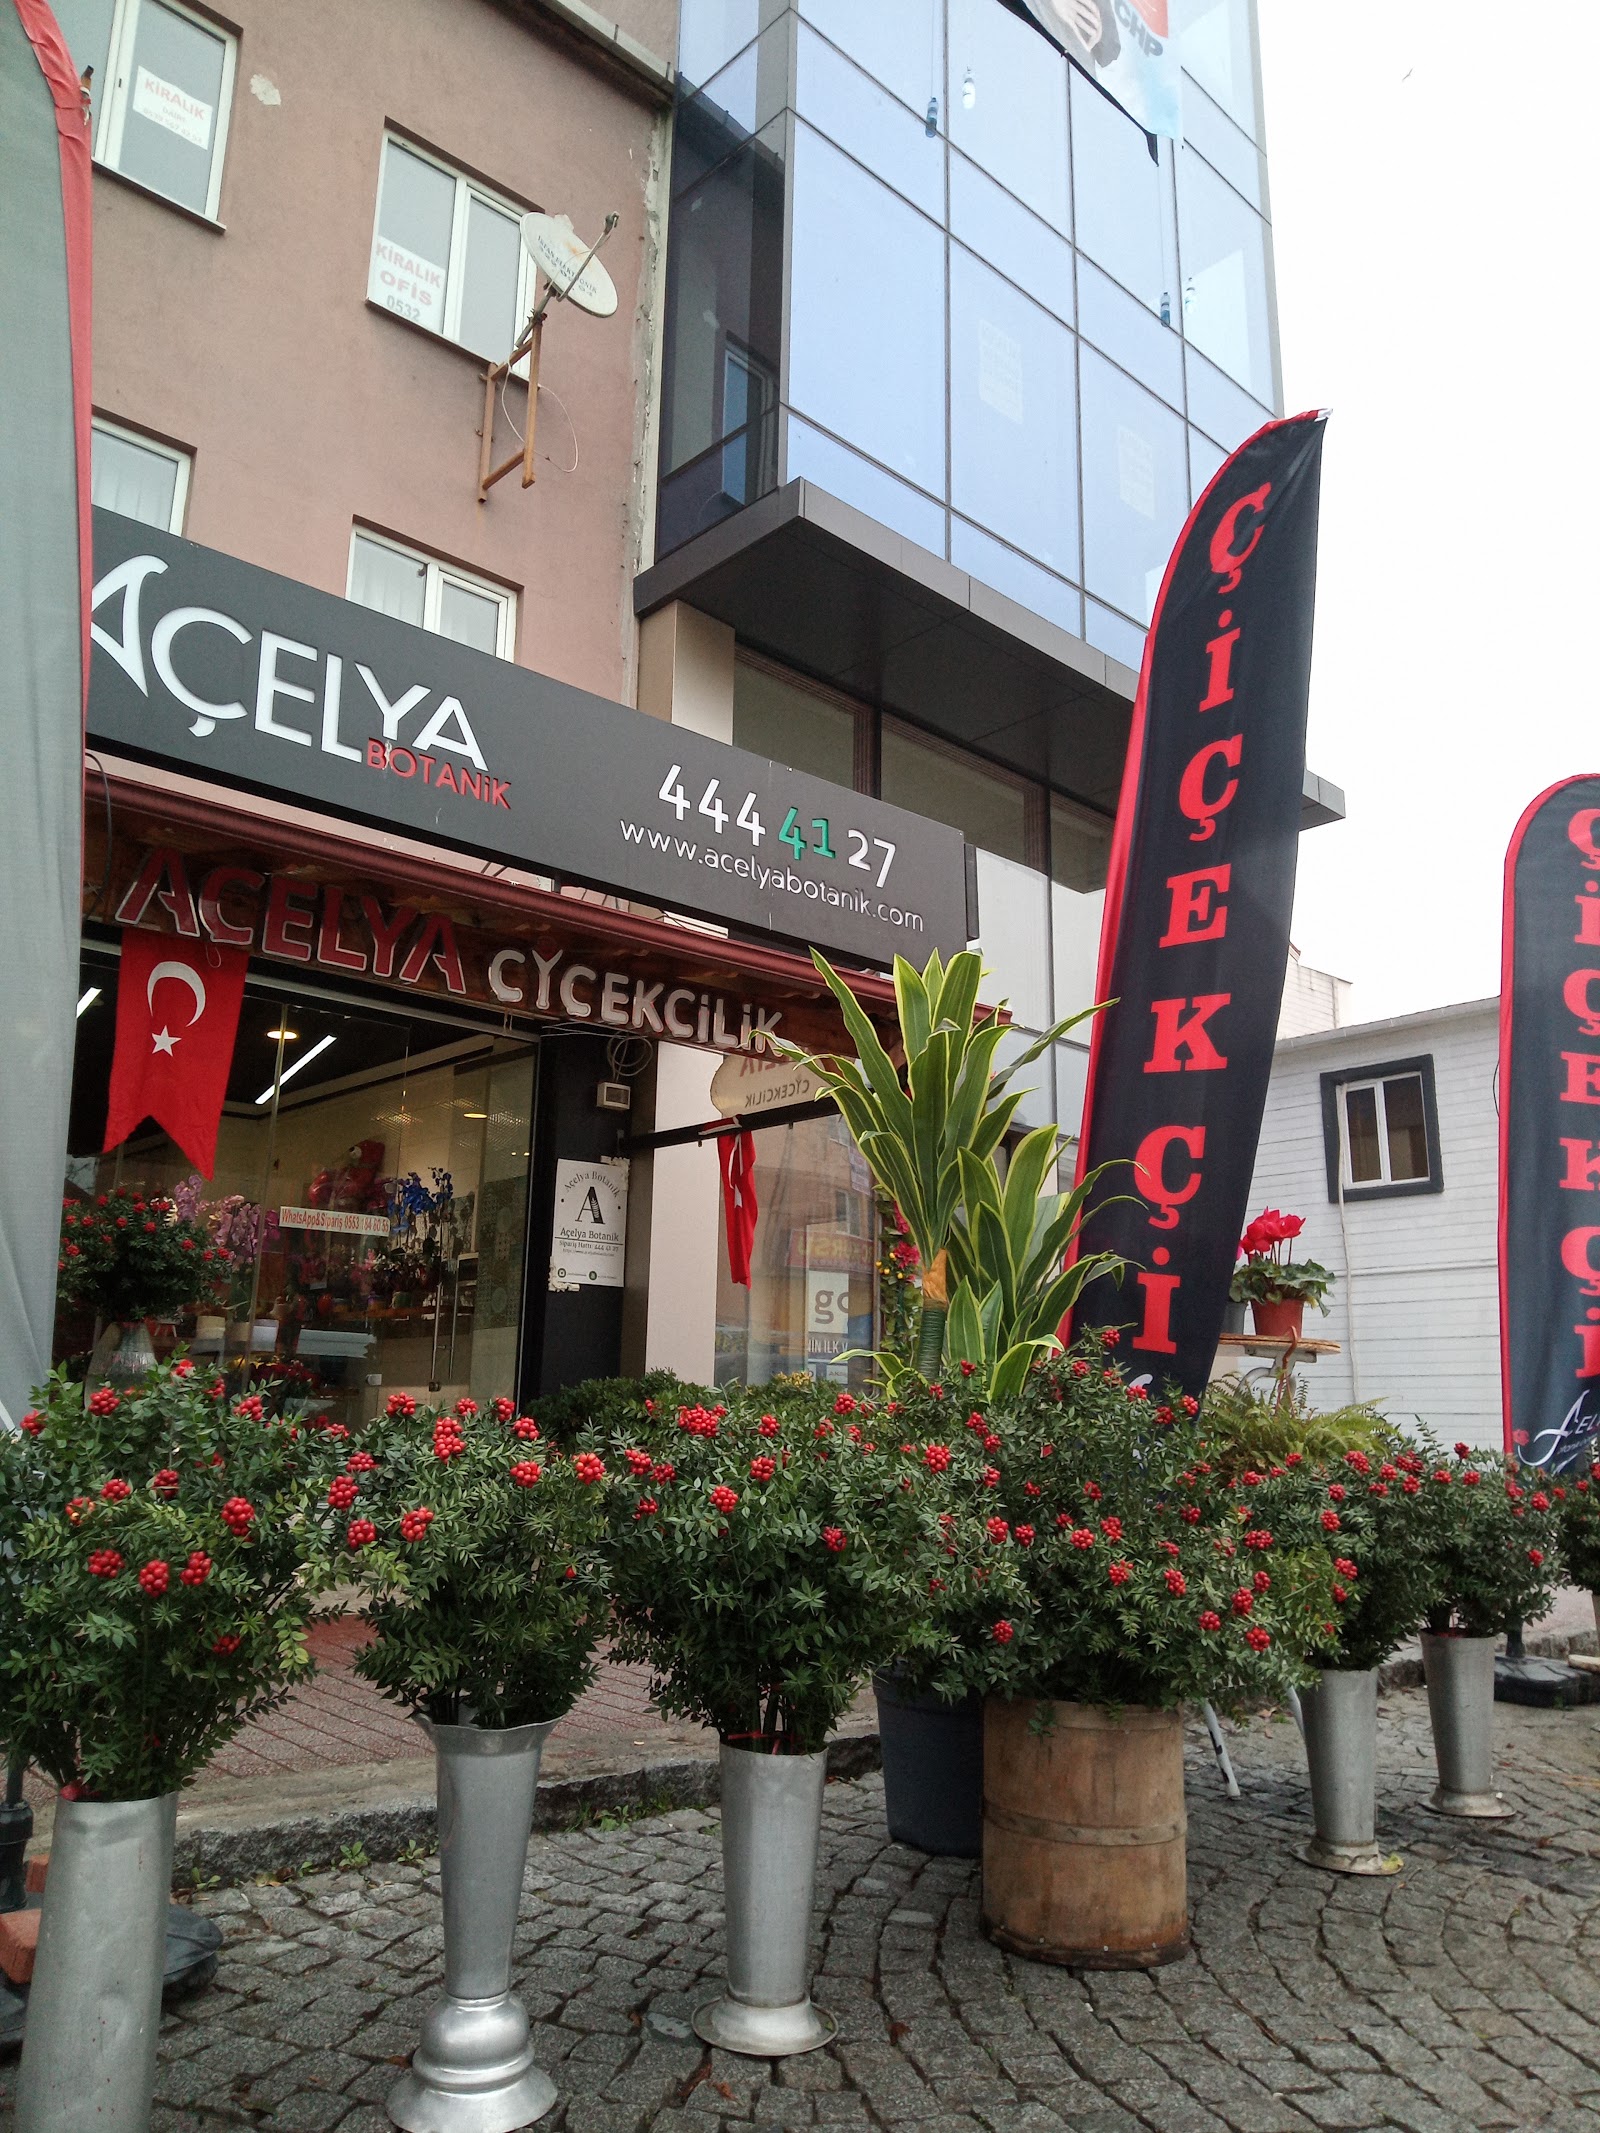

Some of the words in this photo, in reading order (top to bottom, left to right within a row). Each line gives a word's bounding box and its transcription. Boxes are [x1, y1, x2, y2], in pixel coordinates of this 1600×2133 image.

[1114, 0, 1164, 57] CHP
[386, 294, 421, 322] 0532
[658, 763, 767, 847] 444
[777, 806, 836, 861] 41
[847, 828, 897, 889] 27
[619, 818, 925, 933] www.acelyabotanik.com
[559, 1227, 587, 1240] Açelya
[588, 1230, 620, 1242] Botanik
